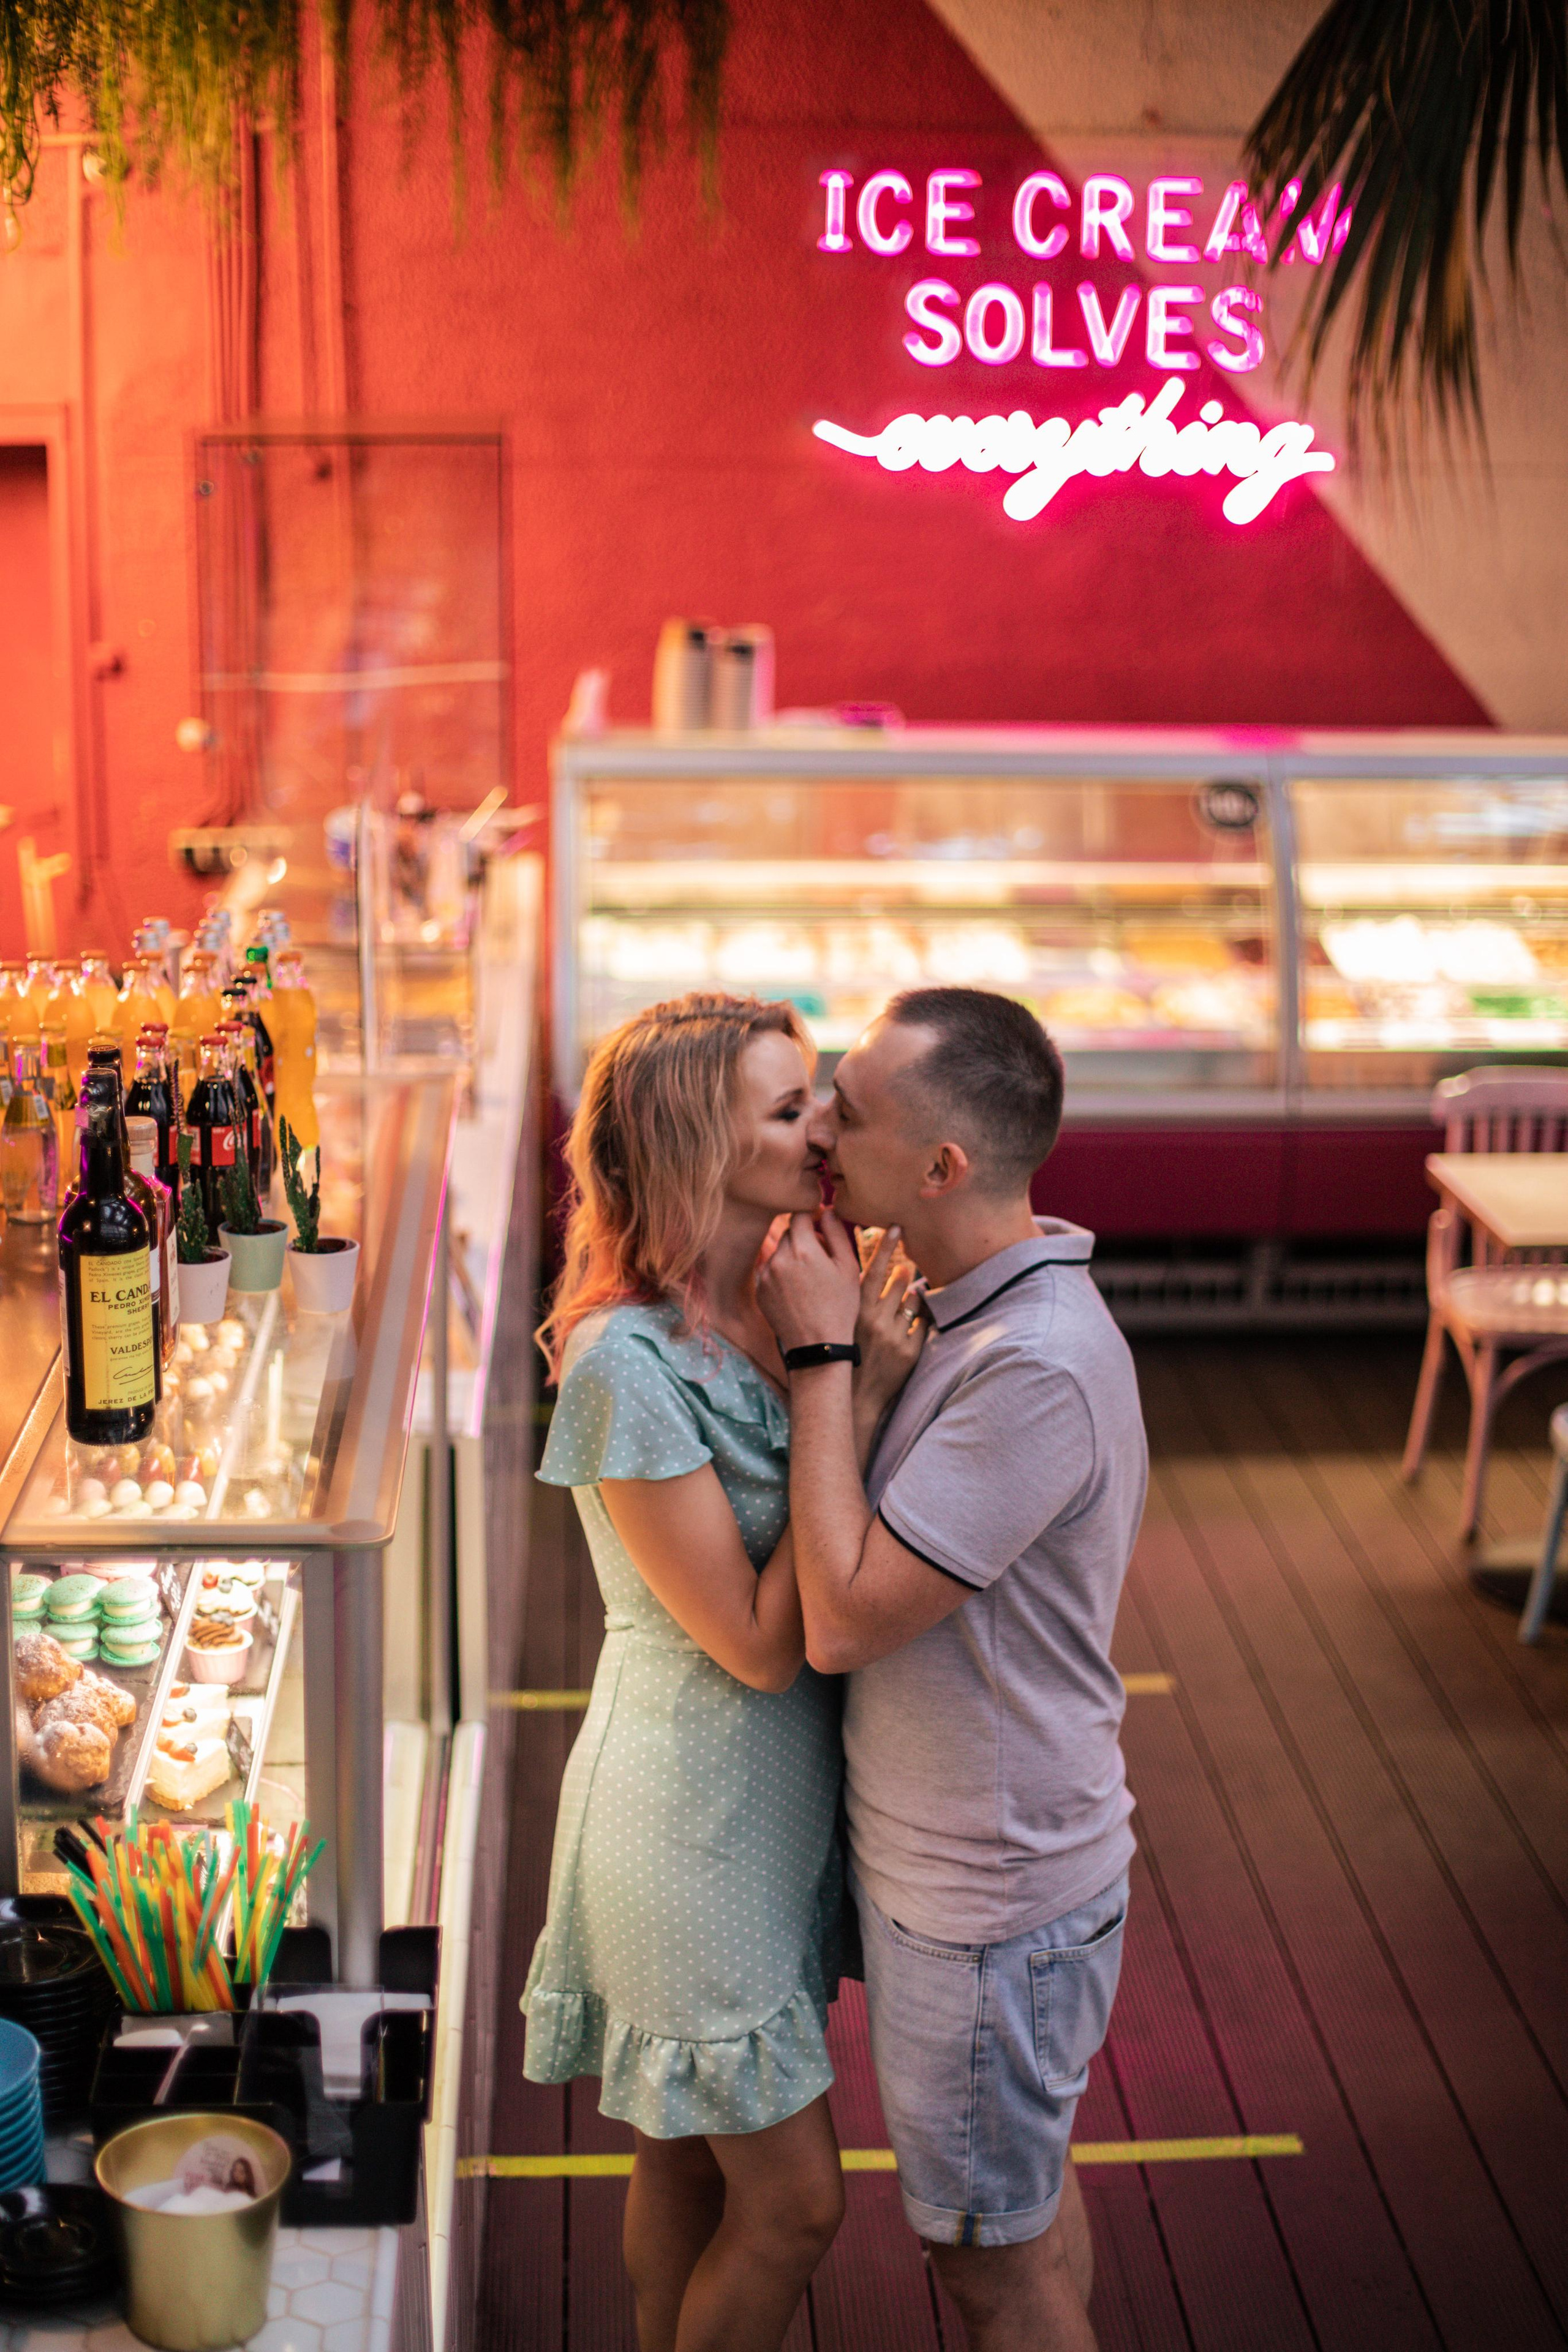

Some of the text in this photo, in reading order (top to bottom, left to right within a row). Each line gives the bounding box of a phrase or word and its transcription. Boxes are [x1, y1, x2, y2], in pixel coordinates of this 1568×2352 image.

[816, 168, 981, 257] ICE
[903, 278, 1265, 373] SOLVES
[812, 375, 1336, 525] everything
[90, 1282, 150, 1303] EL CAND
[108, 1301, 136, 1310] PEDRO
